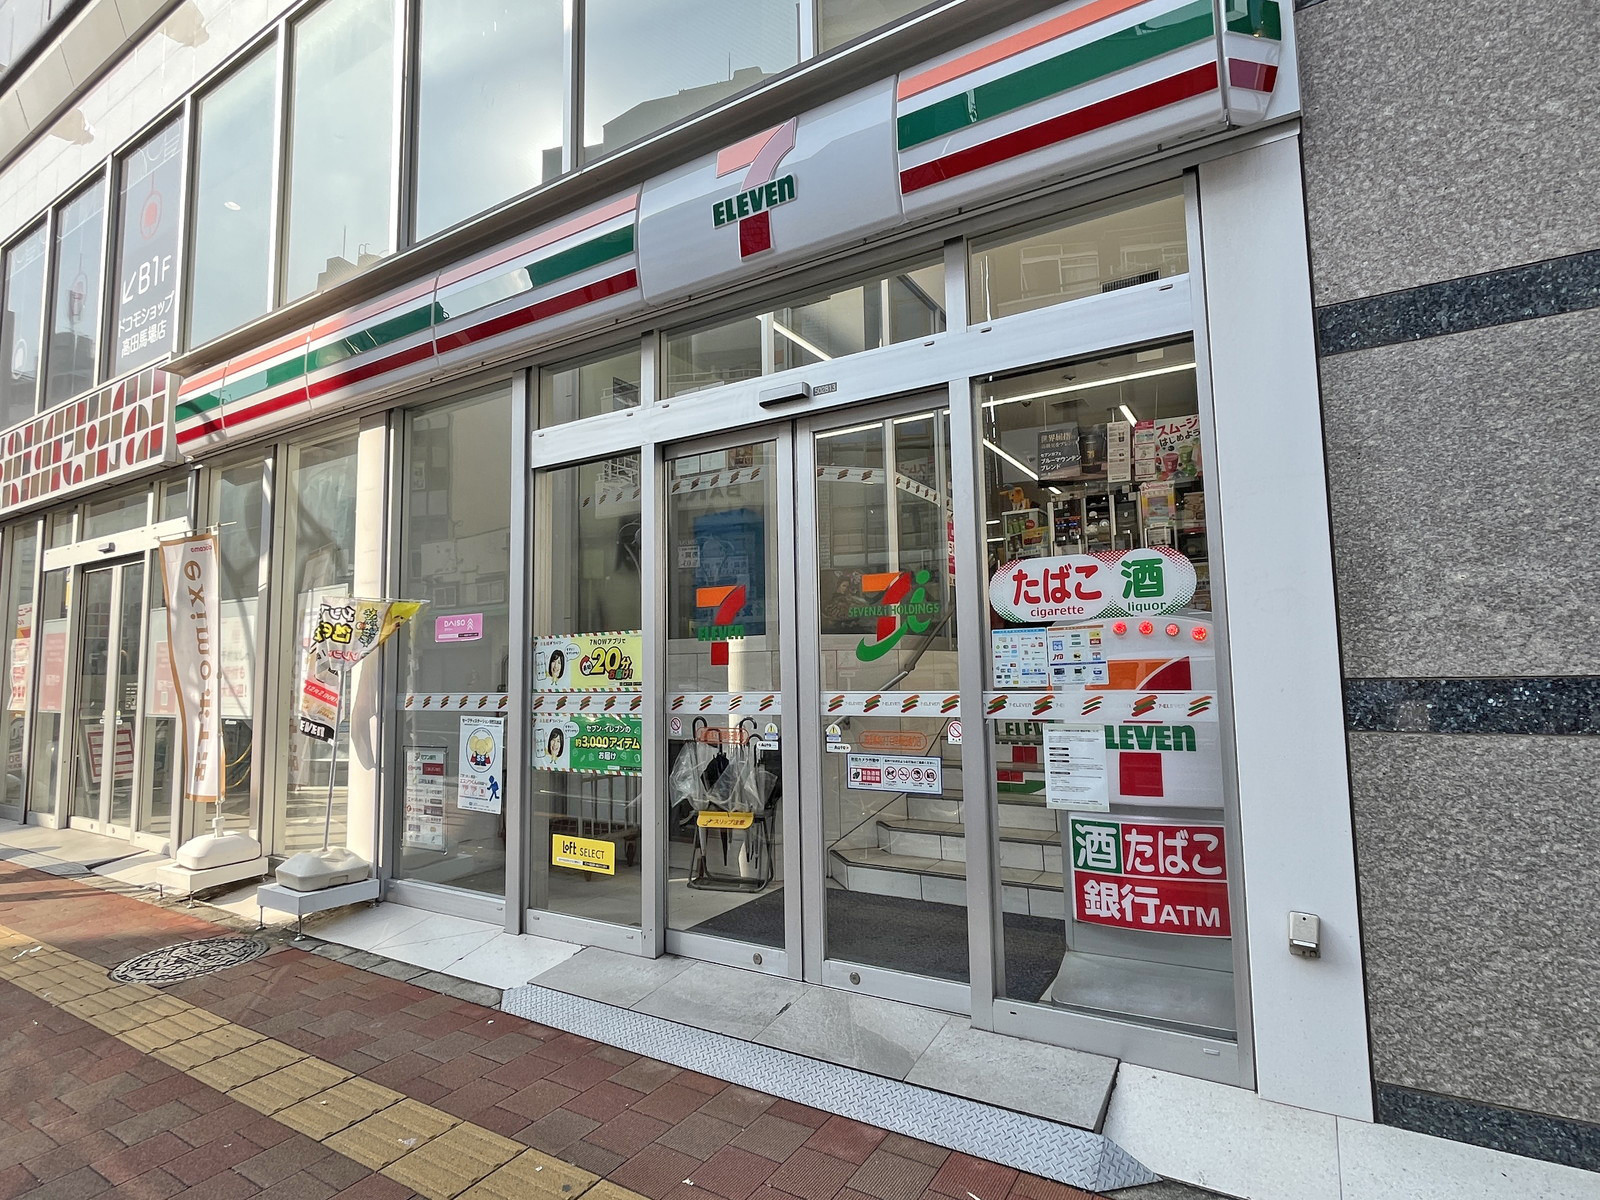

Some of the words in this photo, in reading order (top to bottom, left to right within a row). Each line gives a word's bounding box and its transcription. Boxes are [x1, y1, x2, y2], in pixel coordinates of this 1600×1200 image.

[139, 254, 172, 293] B1F
[118, 290, 175, 337] ドコモショップ
[121, 320, 167, 358] 高田馬場店
[1012, 563, 1102, 606] たばこ
[1121, 557, 1164, 599] 酒
[444, 619, 465, 627] DAISO
[890, 603, 940, 615] HOLDINGS
[1030, 605, 1084, 618] cigarette
[1127, 600, 1167, 613] liquor
[579, 847, 605, 860] SELECT
[1075, 823, 1117, 870] 酒
[1124, 828, 1223, 875] たばこ
